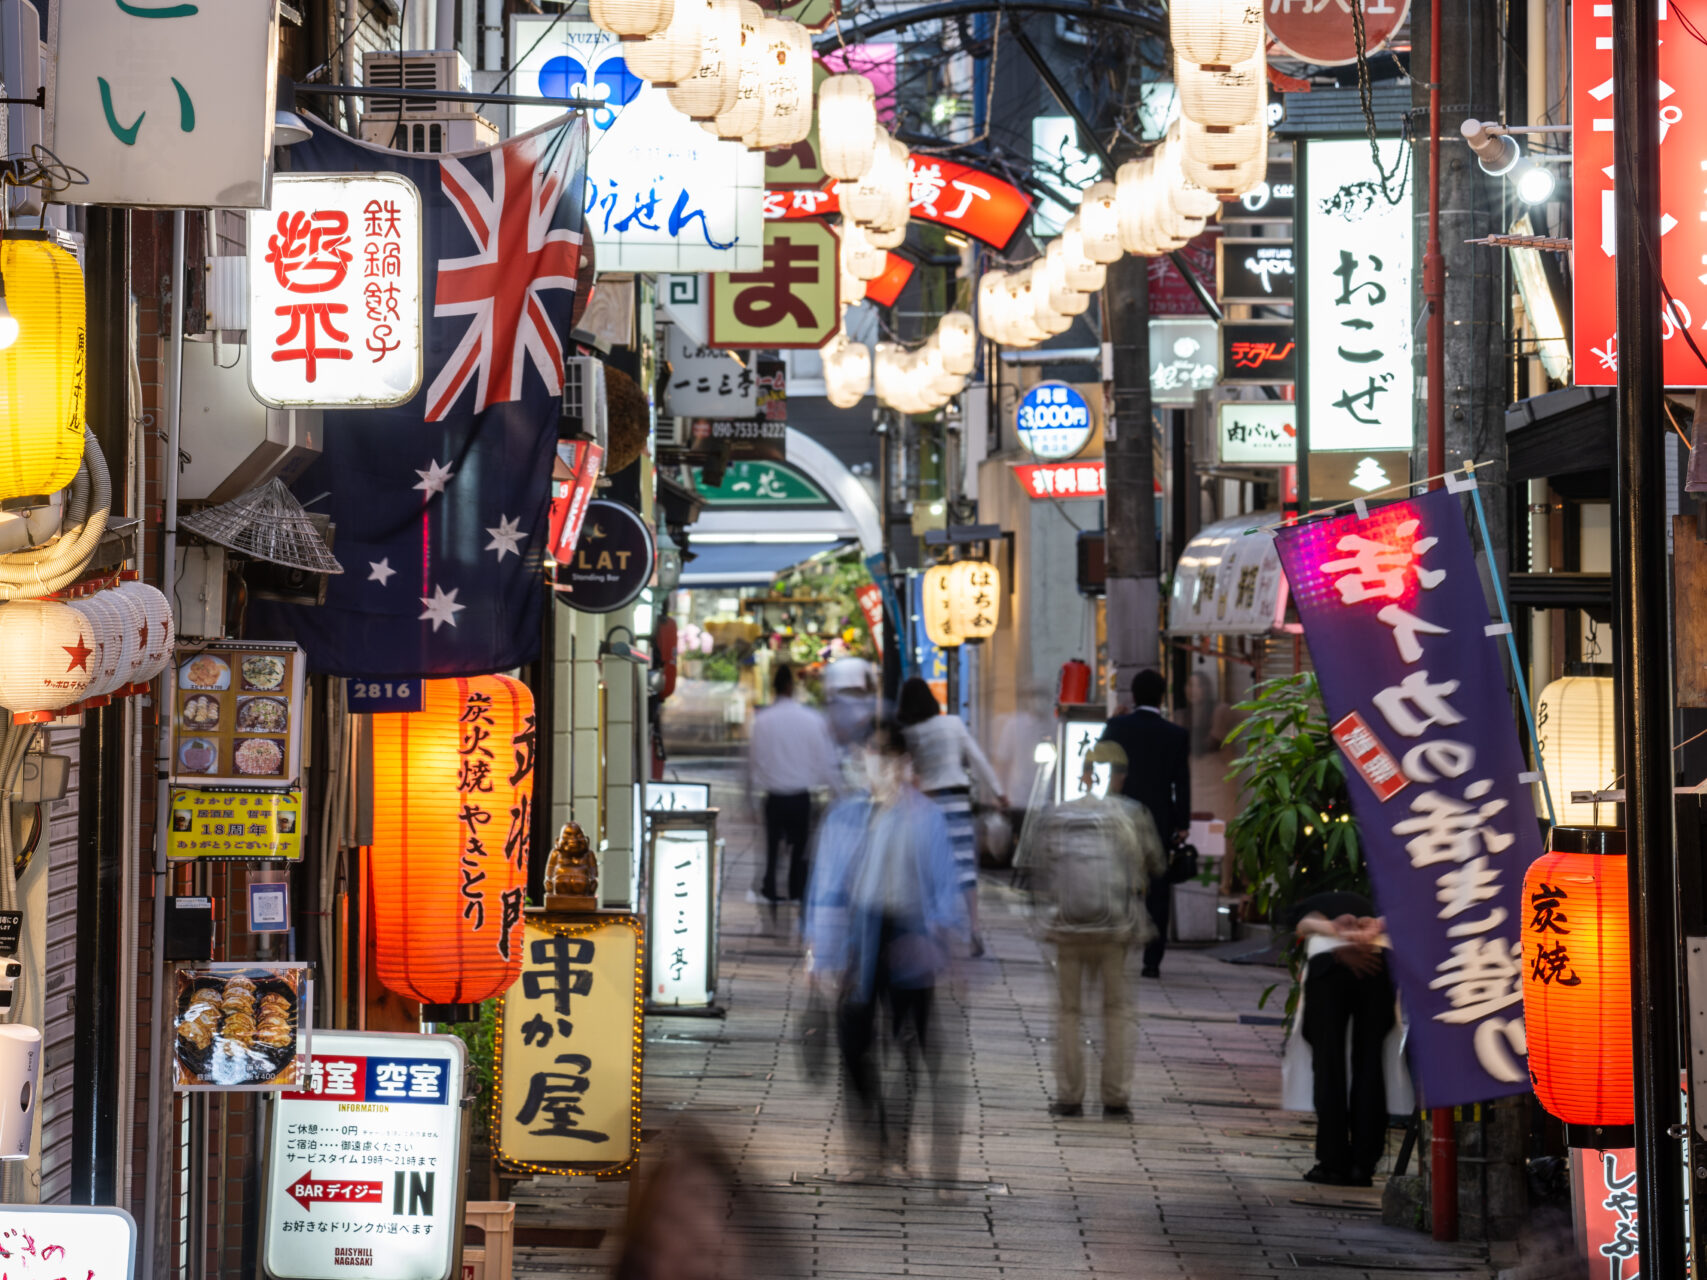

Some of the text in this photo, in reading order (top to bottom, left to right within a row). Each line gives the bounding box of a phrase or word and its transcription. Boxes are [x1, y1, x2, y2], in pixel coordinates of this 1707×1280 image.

[567, 33, 611, 45] YUZEN
[728, 236, 820, 330] ま
[1331, 249, 1395, 425] おこぜ
[673, 369, 754, 398] 一二三亭
[1227, 420, 1281, 443] 肉バル
[563, 550, 632, 571] LAT
[572, 573, 620, 583] Standing Bar
[353, 683, 410, 699] 2816
[193, 797, 281, 806] おかげさまで
[196, 809, 235, 819] 居酒屋
[201, 823, 267, 836] 18周年
[176, 840, 292, 850] ありがとうございます
[1529, 883, 1582, 987] 炭焼
[515, 933, 611, 1144] 串かつ屋
[374, 1062, 442, 1098] 空室
[338, 1103, 390, 1113] INFORMATION
[286, 1153, 358, 1164] サービスタイム
[294, 1183, 382, 1199] BAR デイジー
[392, 1170, 435, 1217] IN
[334, 1247, 373, 1257] DAISYHILL
[334, 1256, 373, 1266] NAGASAKI
